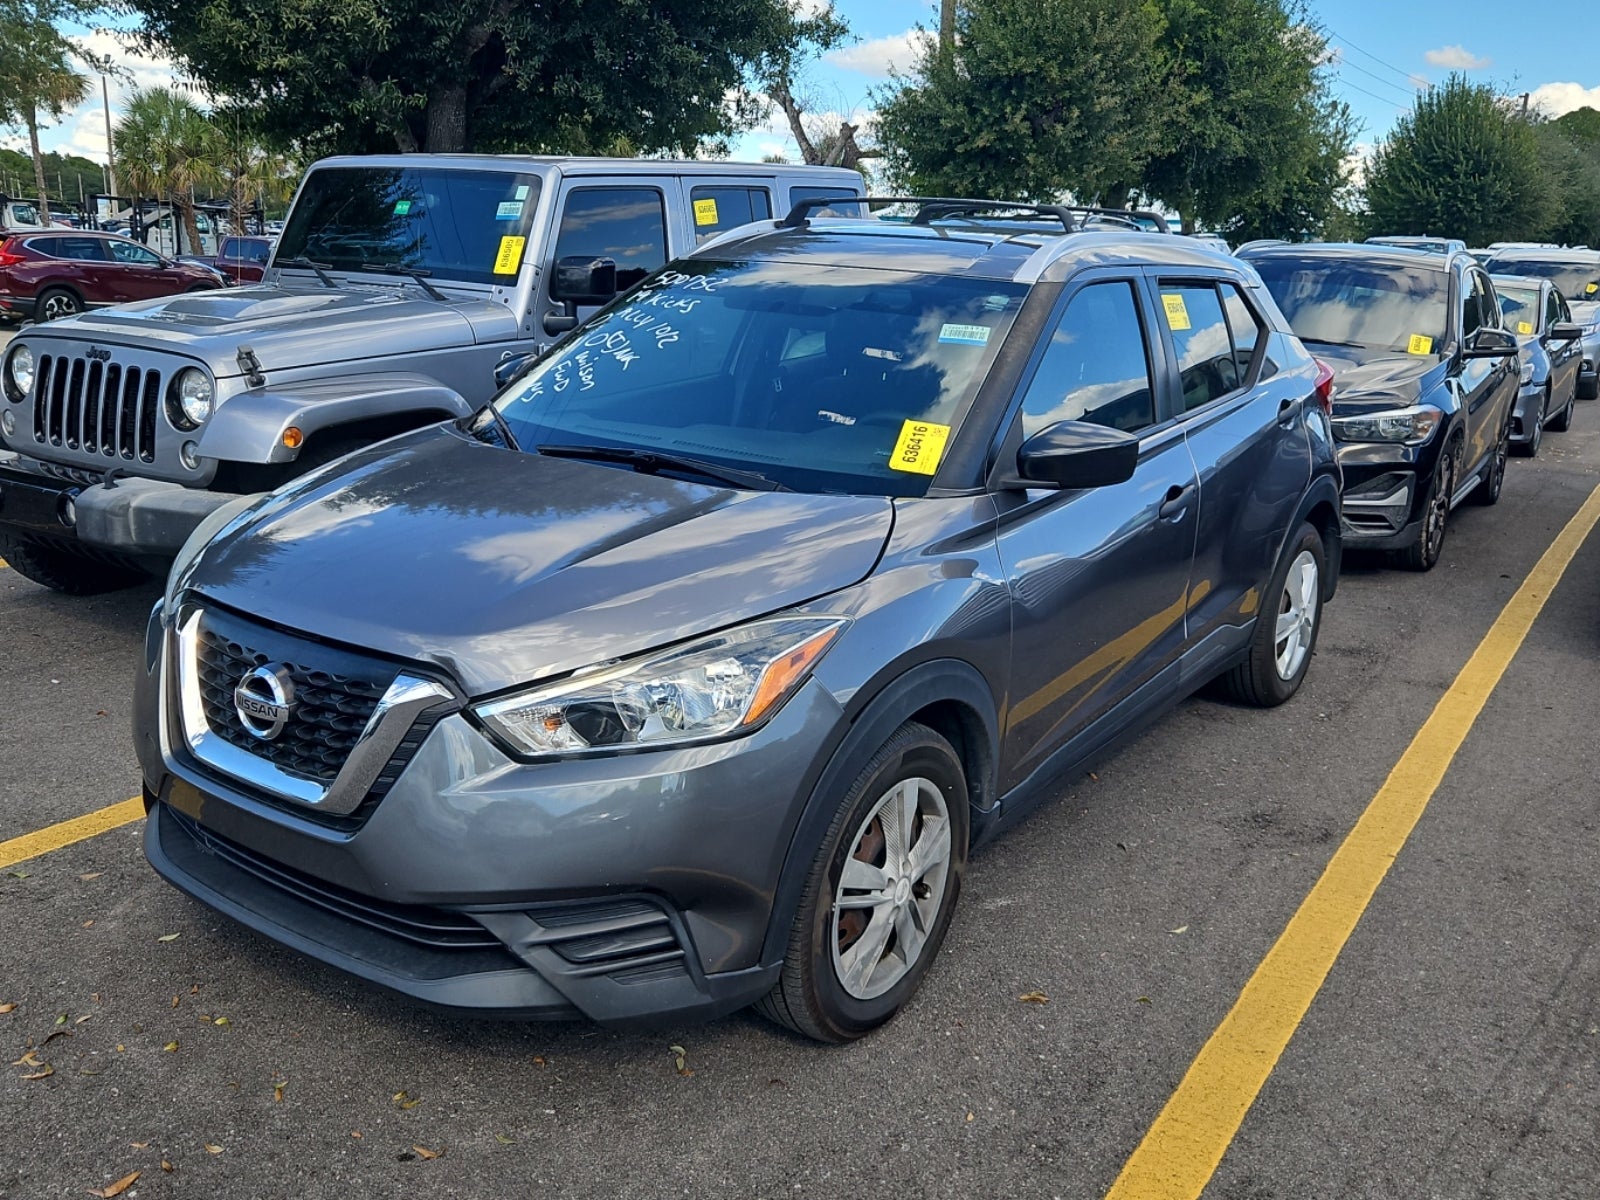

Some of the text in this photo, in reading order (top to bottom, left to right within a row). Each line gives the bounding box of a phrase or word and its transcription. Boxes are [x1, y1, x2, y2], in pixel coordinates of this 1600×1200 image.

[85, 345, 112, 363] Jeep
[902, 425, 928, 464] 636416
[238, 693, 278, 718] NISSAN
